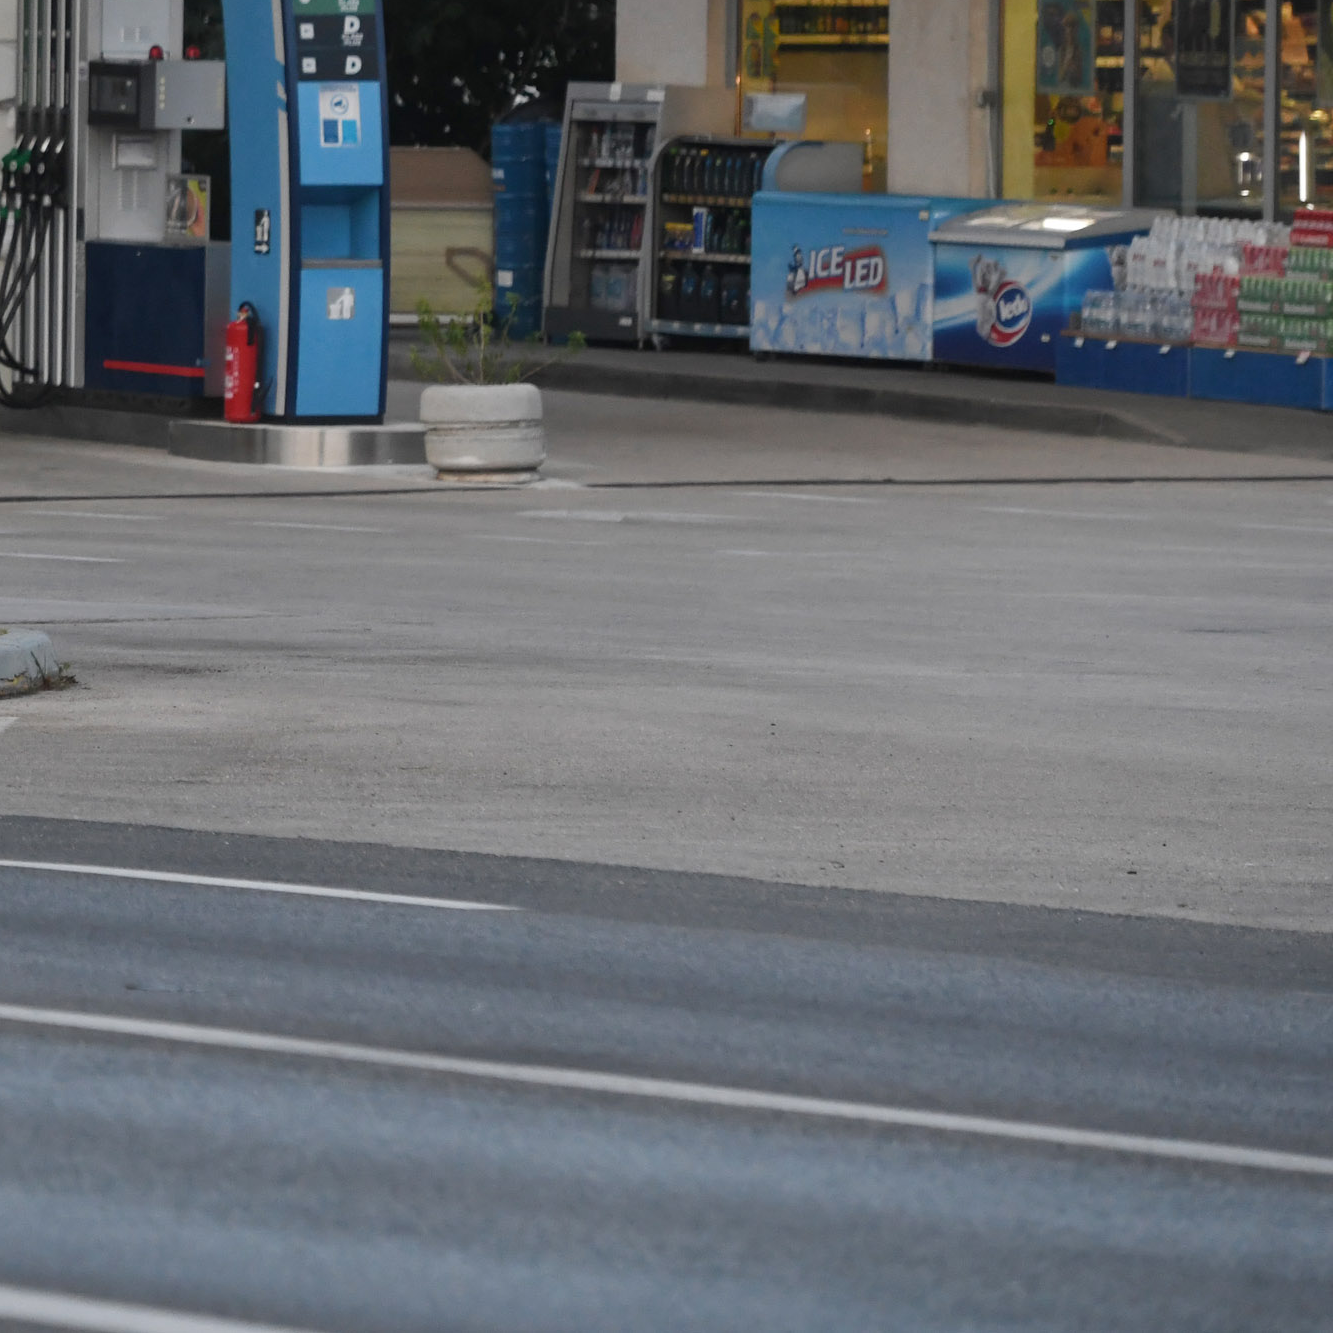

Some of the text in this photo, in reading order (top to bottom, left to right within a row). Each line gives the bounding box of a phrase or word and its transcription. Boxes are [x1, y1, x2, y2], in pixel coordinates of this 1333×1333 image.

[343, 15, 360, 34] D
[345, 55, 362, 75] D
[809, 246, 845, 279] ICE
[844, 256, 883, 289] LED
